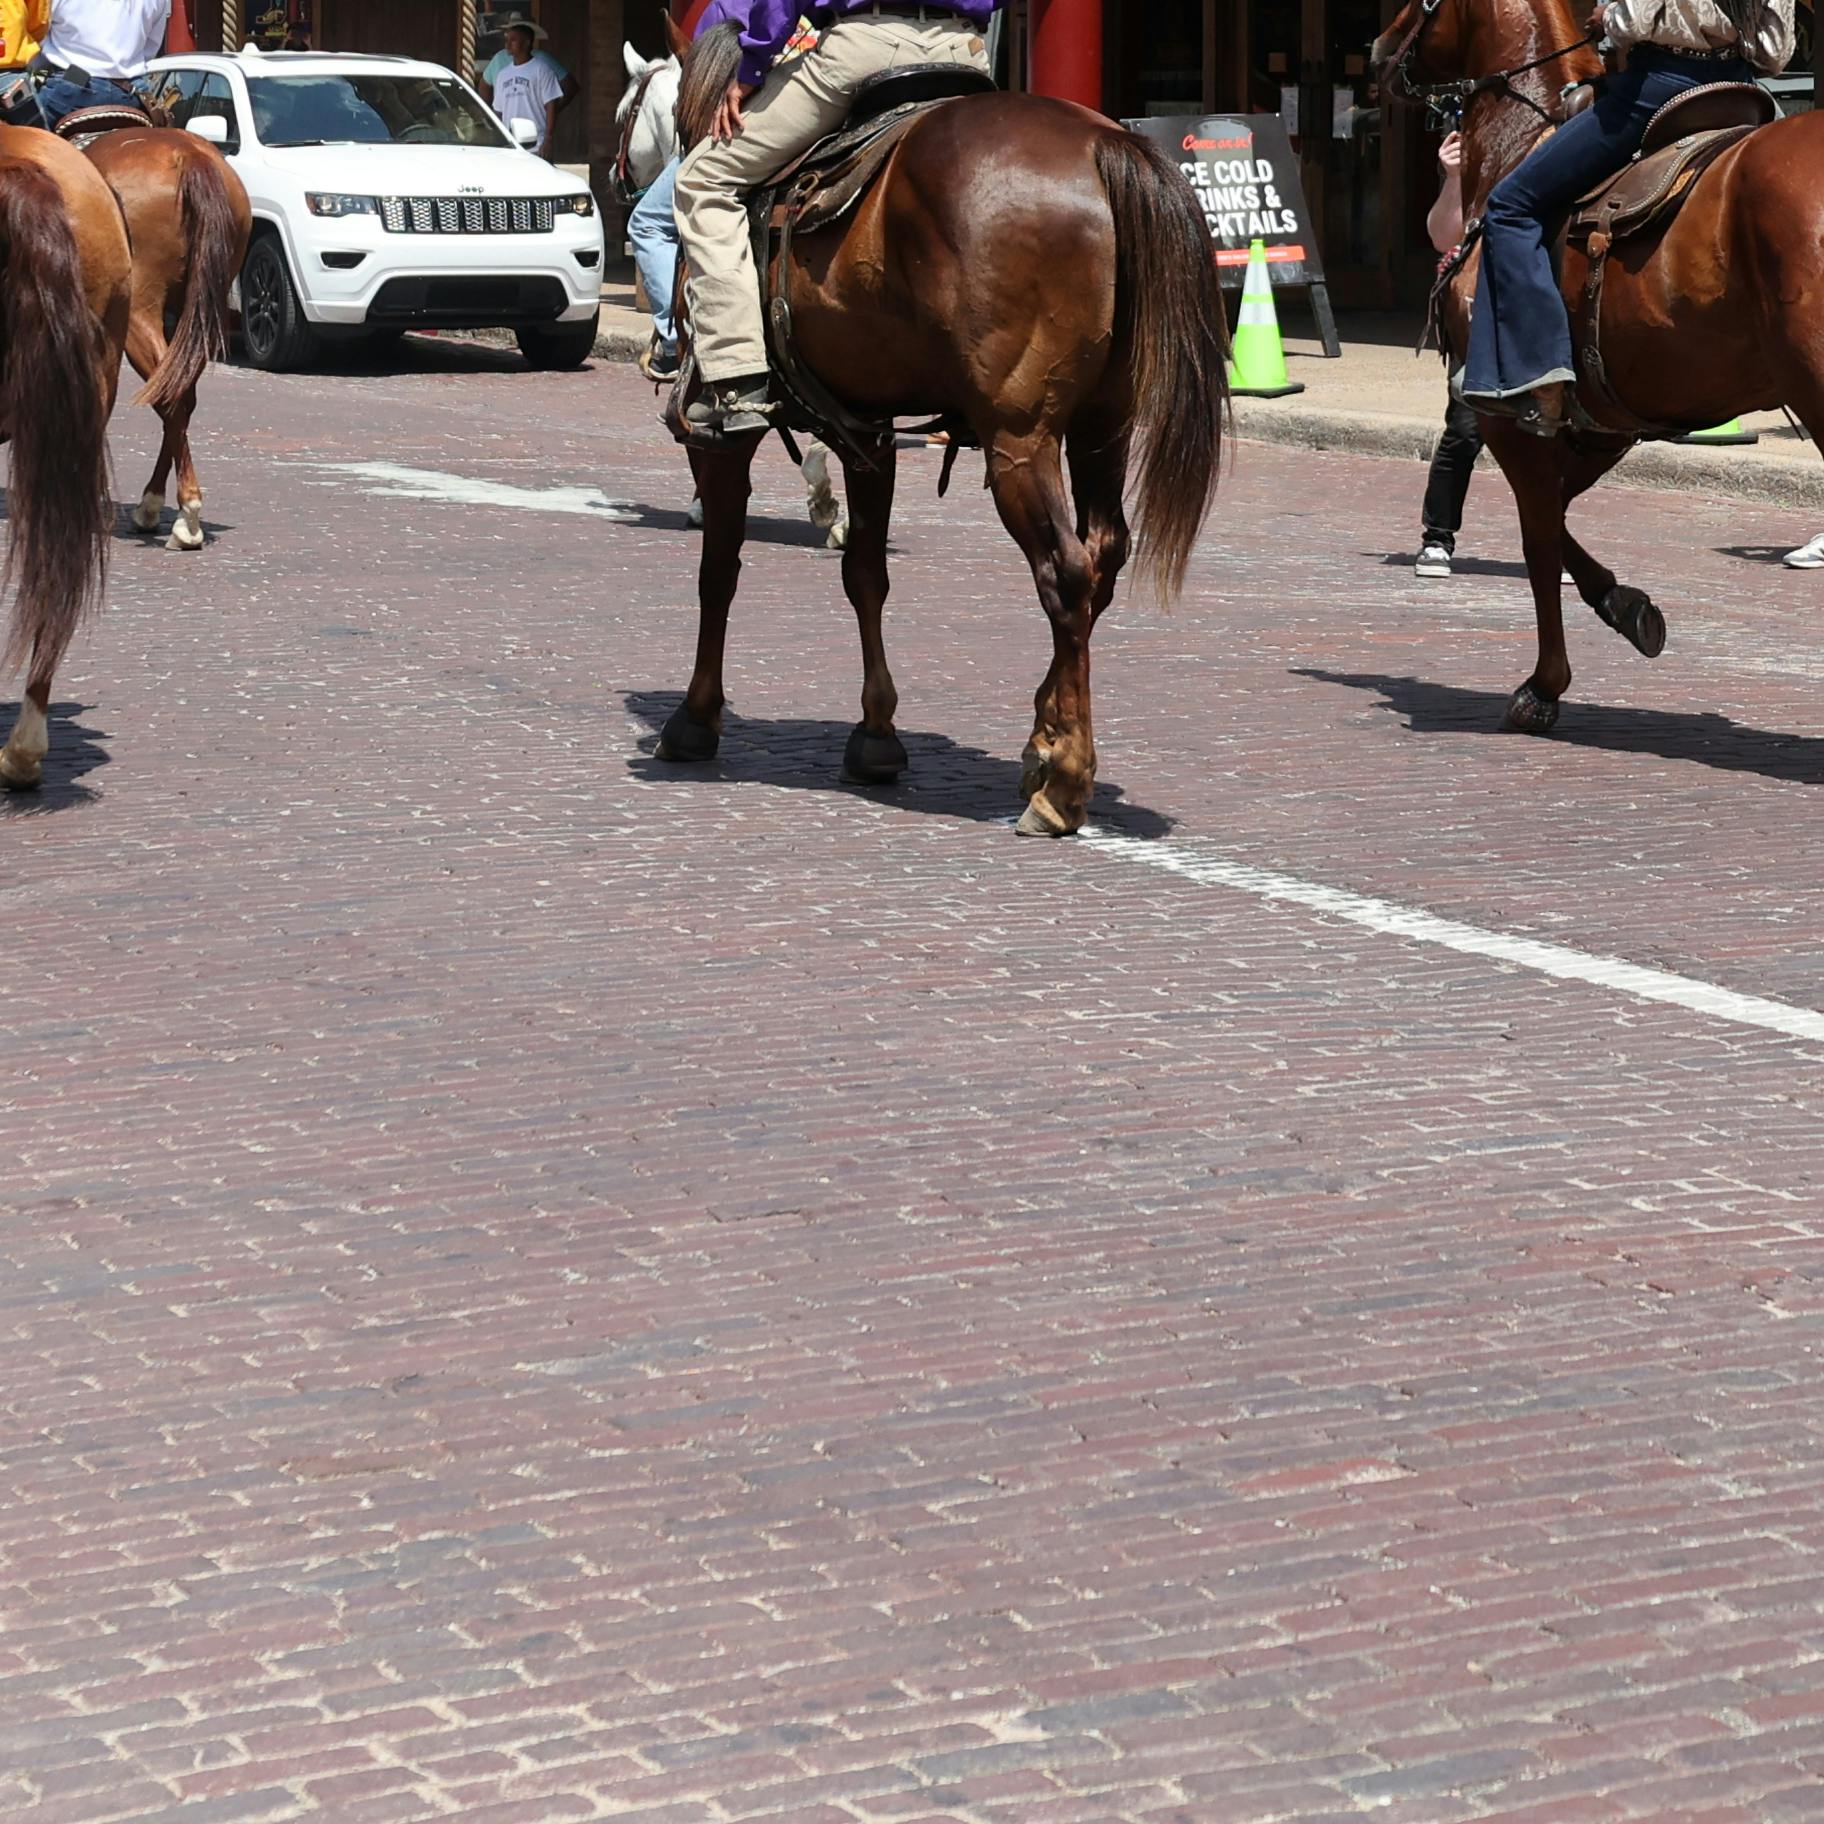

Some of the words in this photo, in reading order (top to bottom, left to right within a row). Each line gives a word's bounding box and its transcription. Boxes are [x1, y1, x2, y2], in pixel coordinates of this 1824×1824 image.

[1182, 134, 1216, 151] Come
[1217, 139, 1232, 149] on
[1180, 162, 1211, 186] CE
[1214, 159, 1274, 185] COLD
[457, 184, 484, 196] Jeep
[1194, 185, 1261, 211] RINKS
[1264, 184, 1282, 208] &
[1204, 209, 1298, 237] CKTAILS
